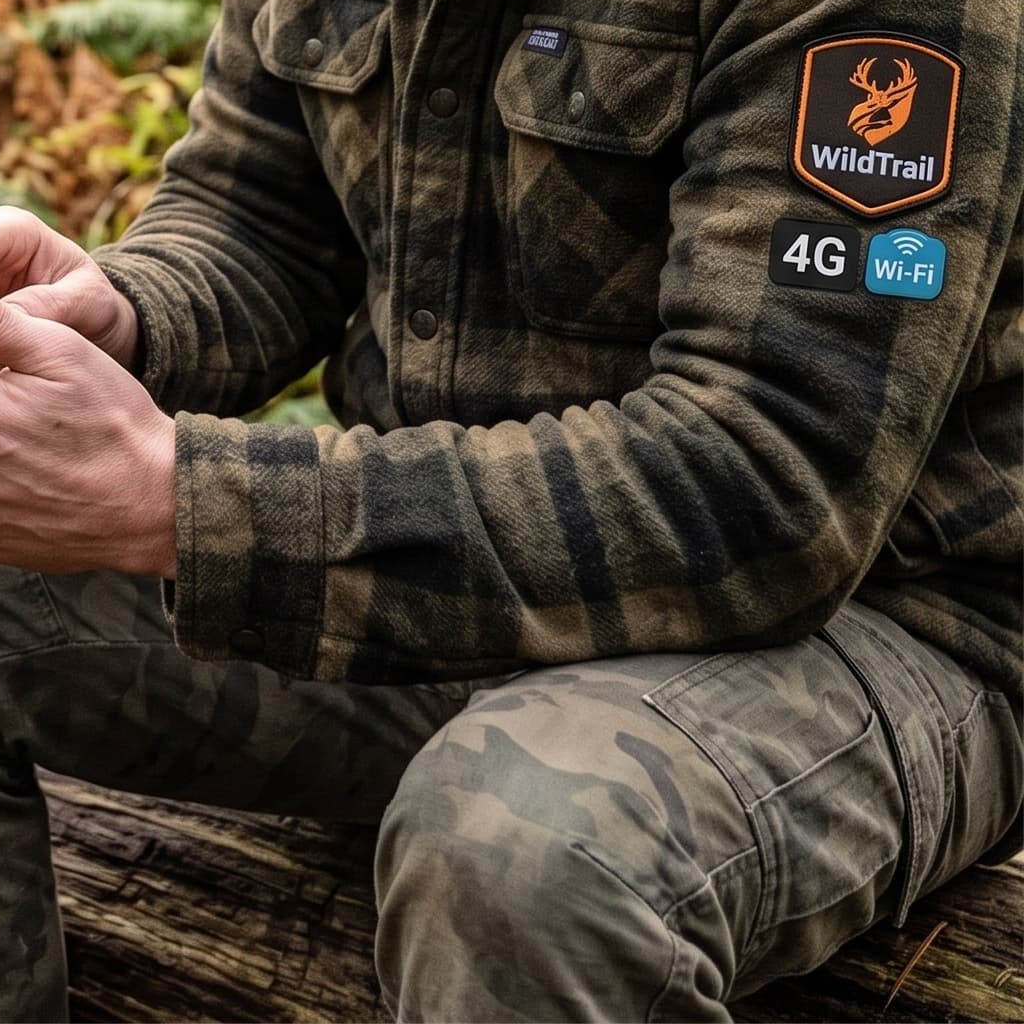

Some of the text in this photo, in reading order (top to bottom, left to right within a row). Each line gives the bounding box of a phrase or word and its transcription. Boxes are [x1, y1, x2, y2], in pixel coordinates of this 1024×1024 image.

[811, 144, 935, 182] WildTrail
[782, 233, 847, 277] 4G
[874, 258, 934, 285] Wi-Fi
